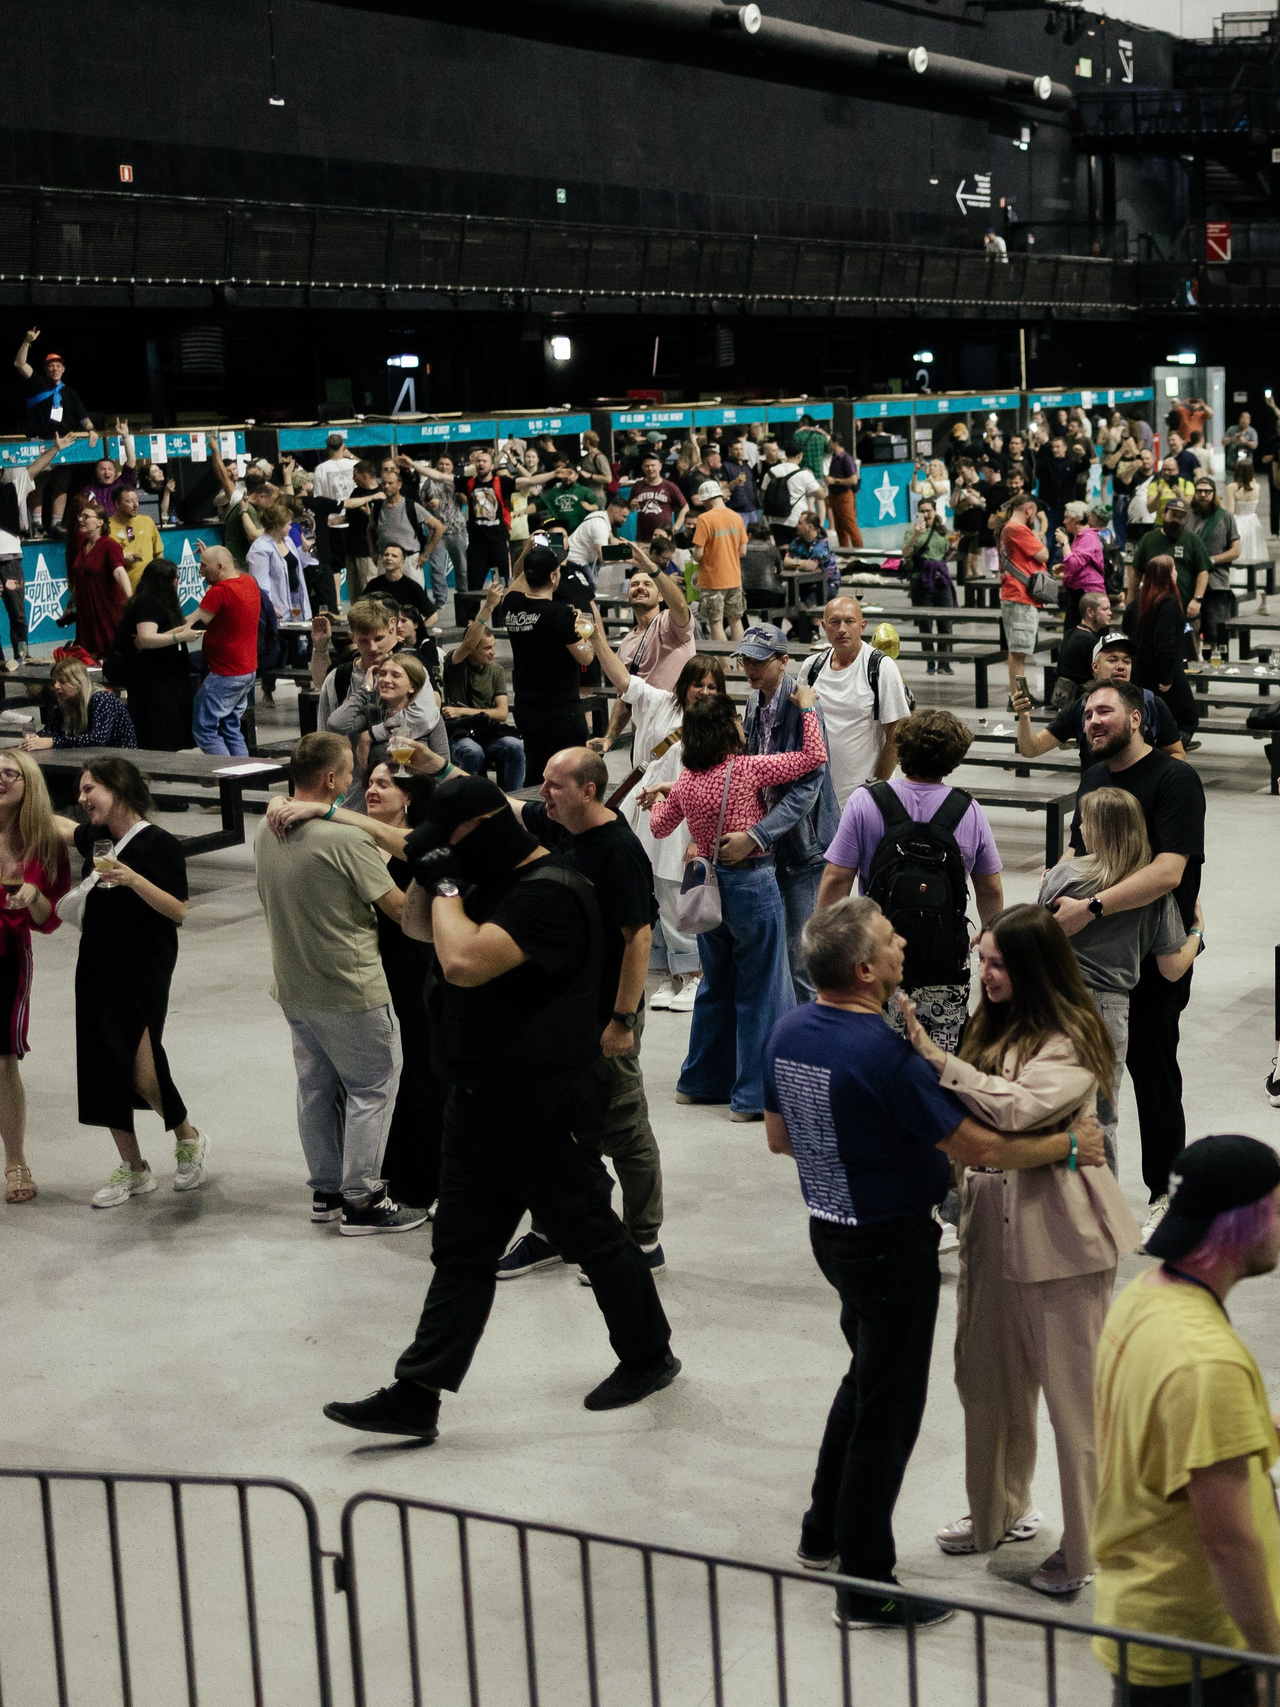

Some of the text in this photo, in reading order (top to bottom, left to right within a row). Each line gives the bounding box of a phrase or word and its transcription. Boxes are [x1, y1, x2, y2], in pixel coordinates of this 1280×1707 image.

[183, 555, 195, 566] FEST
[37, 571, 49, 582] FEST
[25, 581, 68, 604] TOPCRAFT
[179, 586, 206, 606] BEER
[32, 603, 62, 629] BEER
